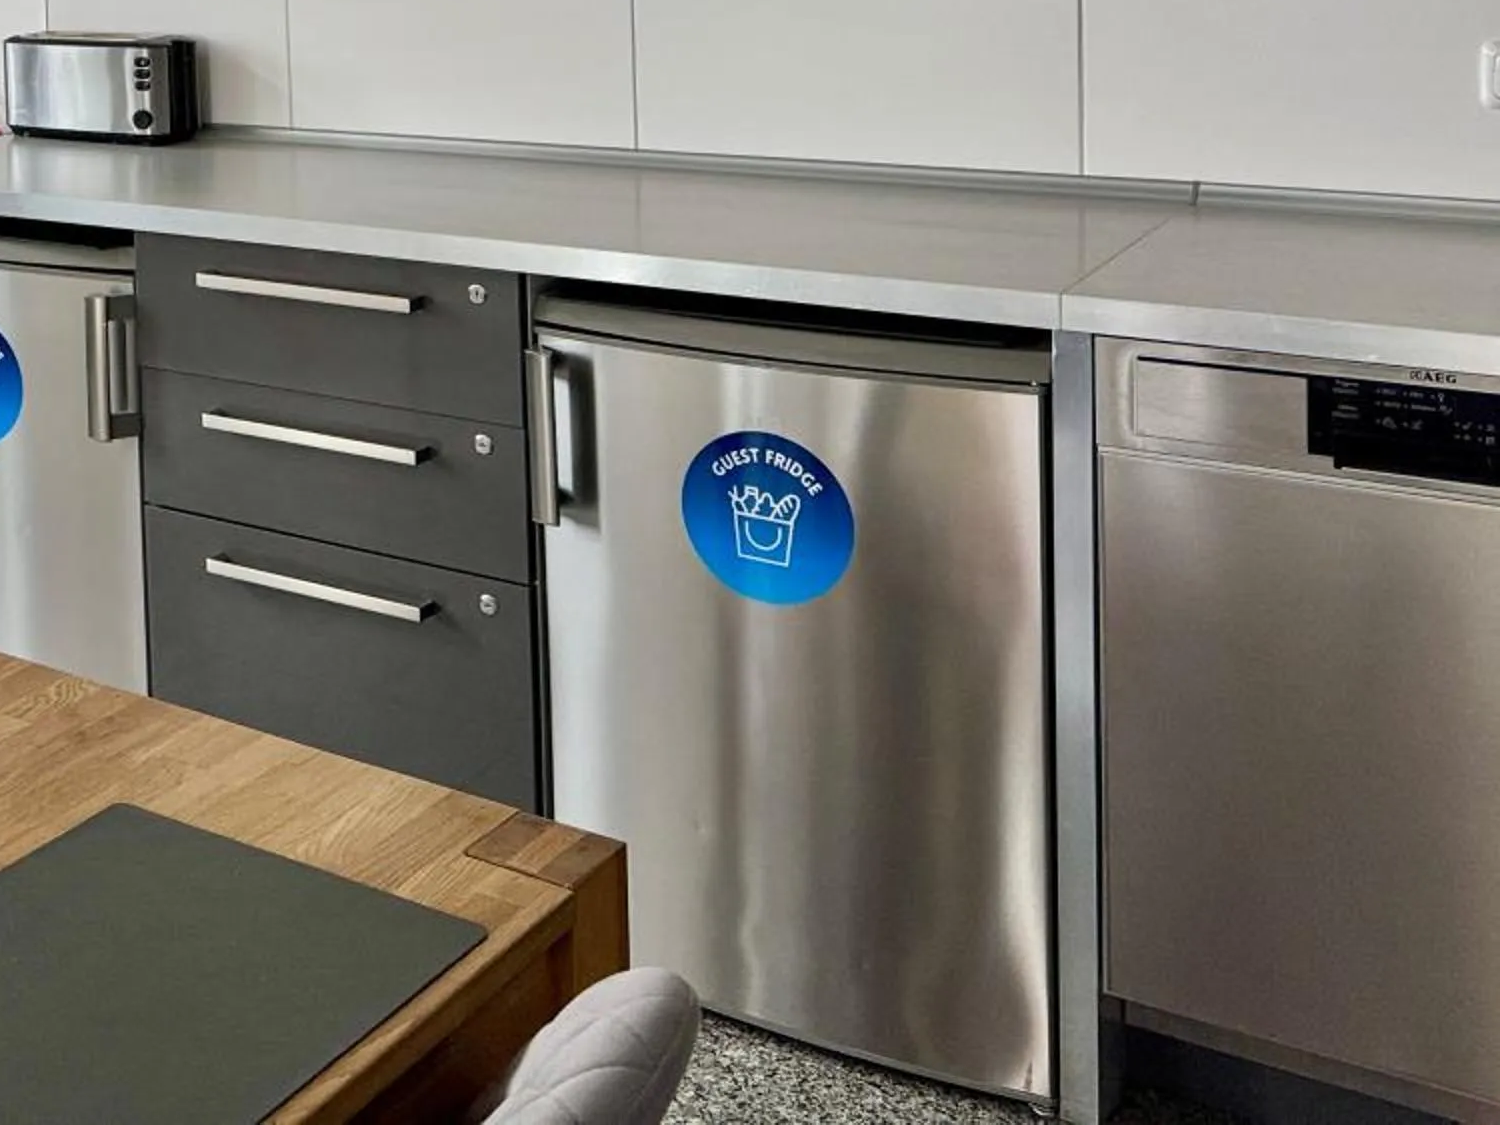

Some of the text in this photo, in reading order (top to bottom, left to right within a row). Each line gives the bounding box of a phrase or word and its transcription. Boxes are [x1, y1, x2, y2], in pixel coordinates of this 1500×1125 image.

[1424, 371, 1457, 384] AEG
[711, 447, 824, 498] GUEST FRIDGE
